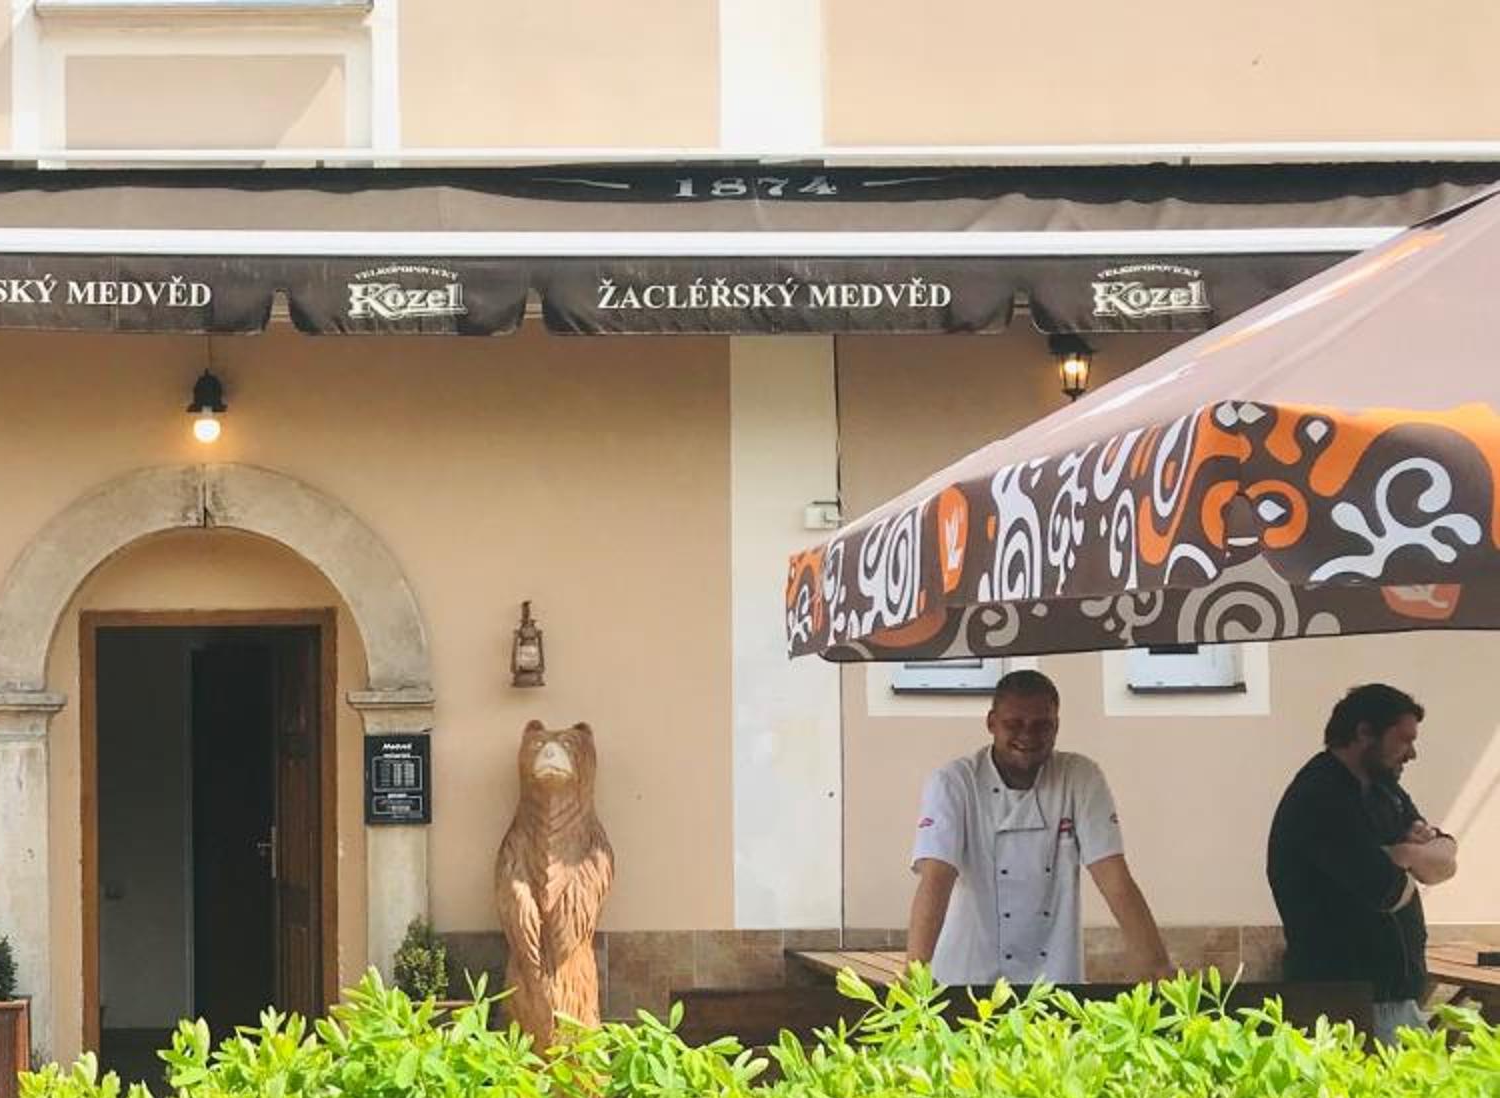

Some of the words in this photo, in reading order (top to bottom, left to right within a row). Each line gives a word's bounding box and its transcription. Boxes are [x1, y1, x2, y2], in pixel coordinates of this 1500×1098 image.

[676, 176, 837, 197] 1874
[67, 276, 212, 307] MEDVĚD
[348, 282, 468, 321] Kozel
[597, 278, 798, 310] ŽACLÉŘSKÝ
[809, 278, 952, 308] MEDVĚD
[1091, 280, 1214, 319] Kozel
